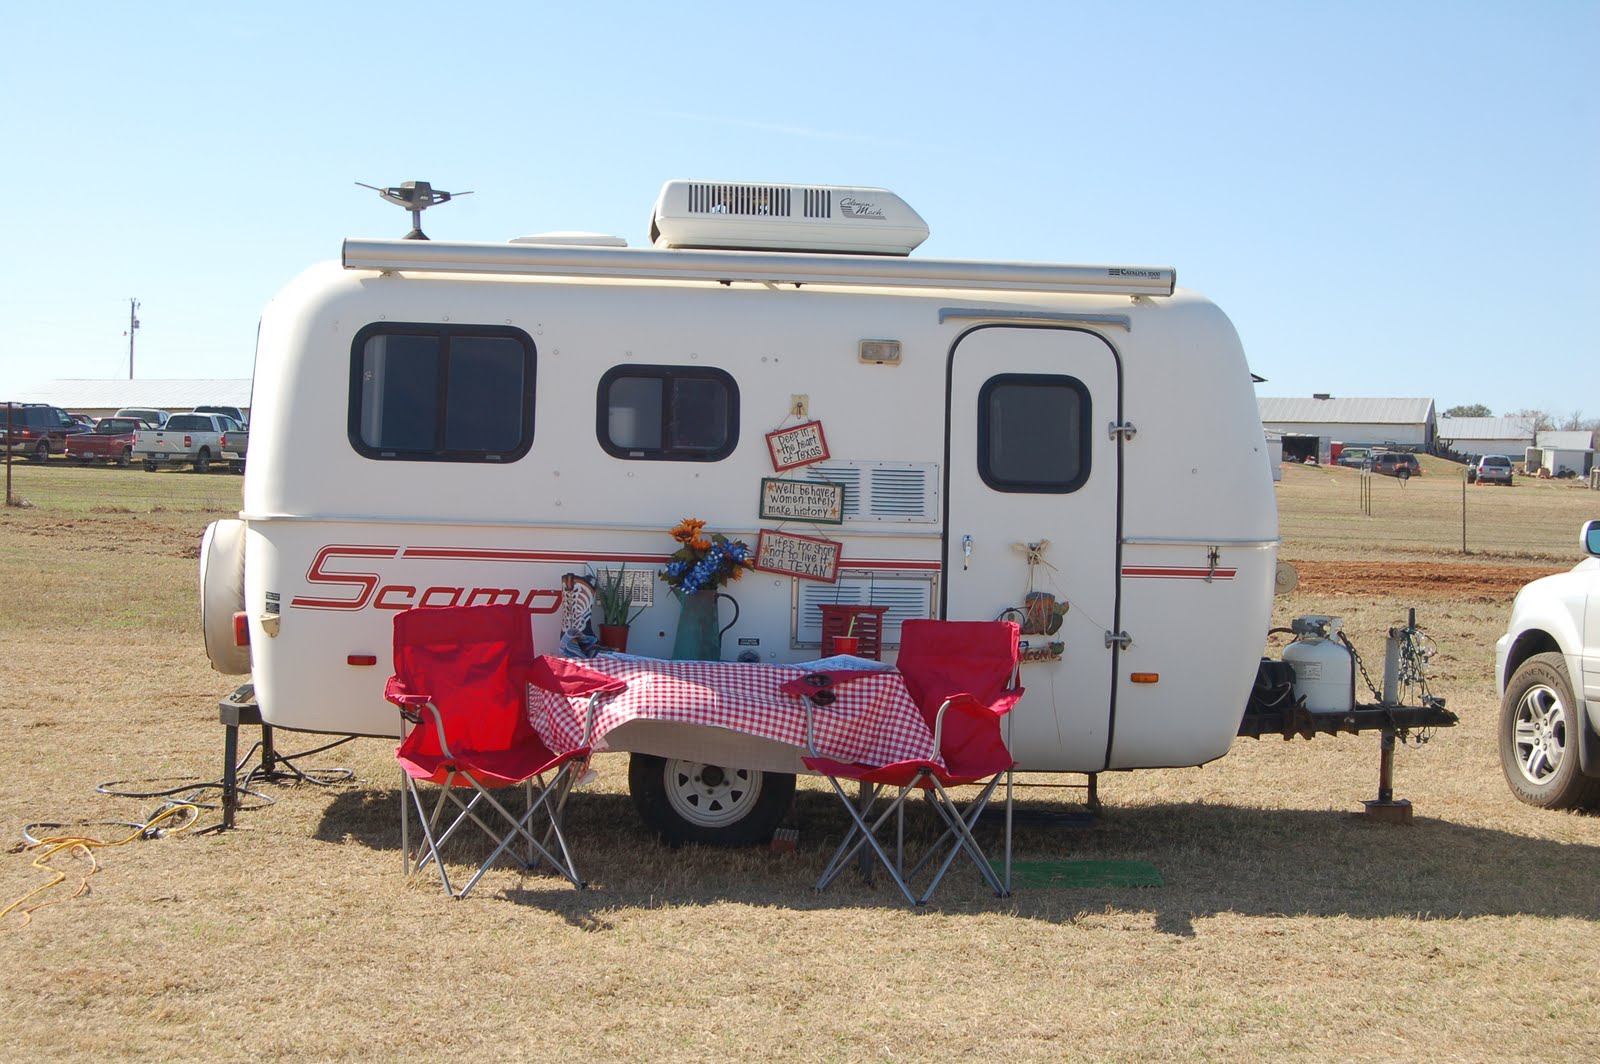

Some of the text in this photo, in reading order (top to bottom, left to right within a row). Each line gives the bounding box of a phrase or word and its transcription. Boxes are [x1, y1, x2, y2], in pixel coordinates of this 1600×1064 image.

[778, 428, 810, 444] Deep in
[781, 434, 817, 454] the heart
[783, 446, 821, 463] of Texas
[774, 482, 836, 498] Well behaved
[808, 497, 836, 508] rarely
[768, 505, 828, 518] make history
[797, 540, 812, 551] too
[769, 548, 829, 565] not to live it
[762, 558, 827, 577] as a TEXAN
